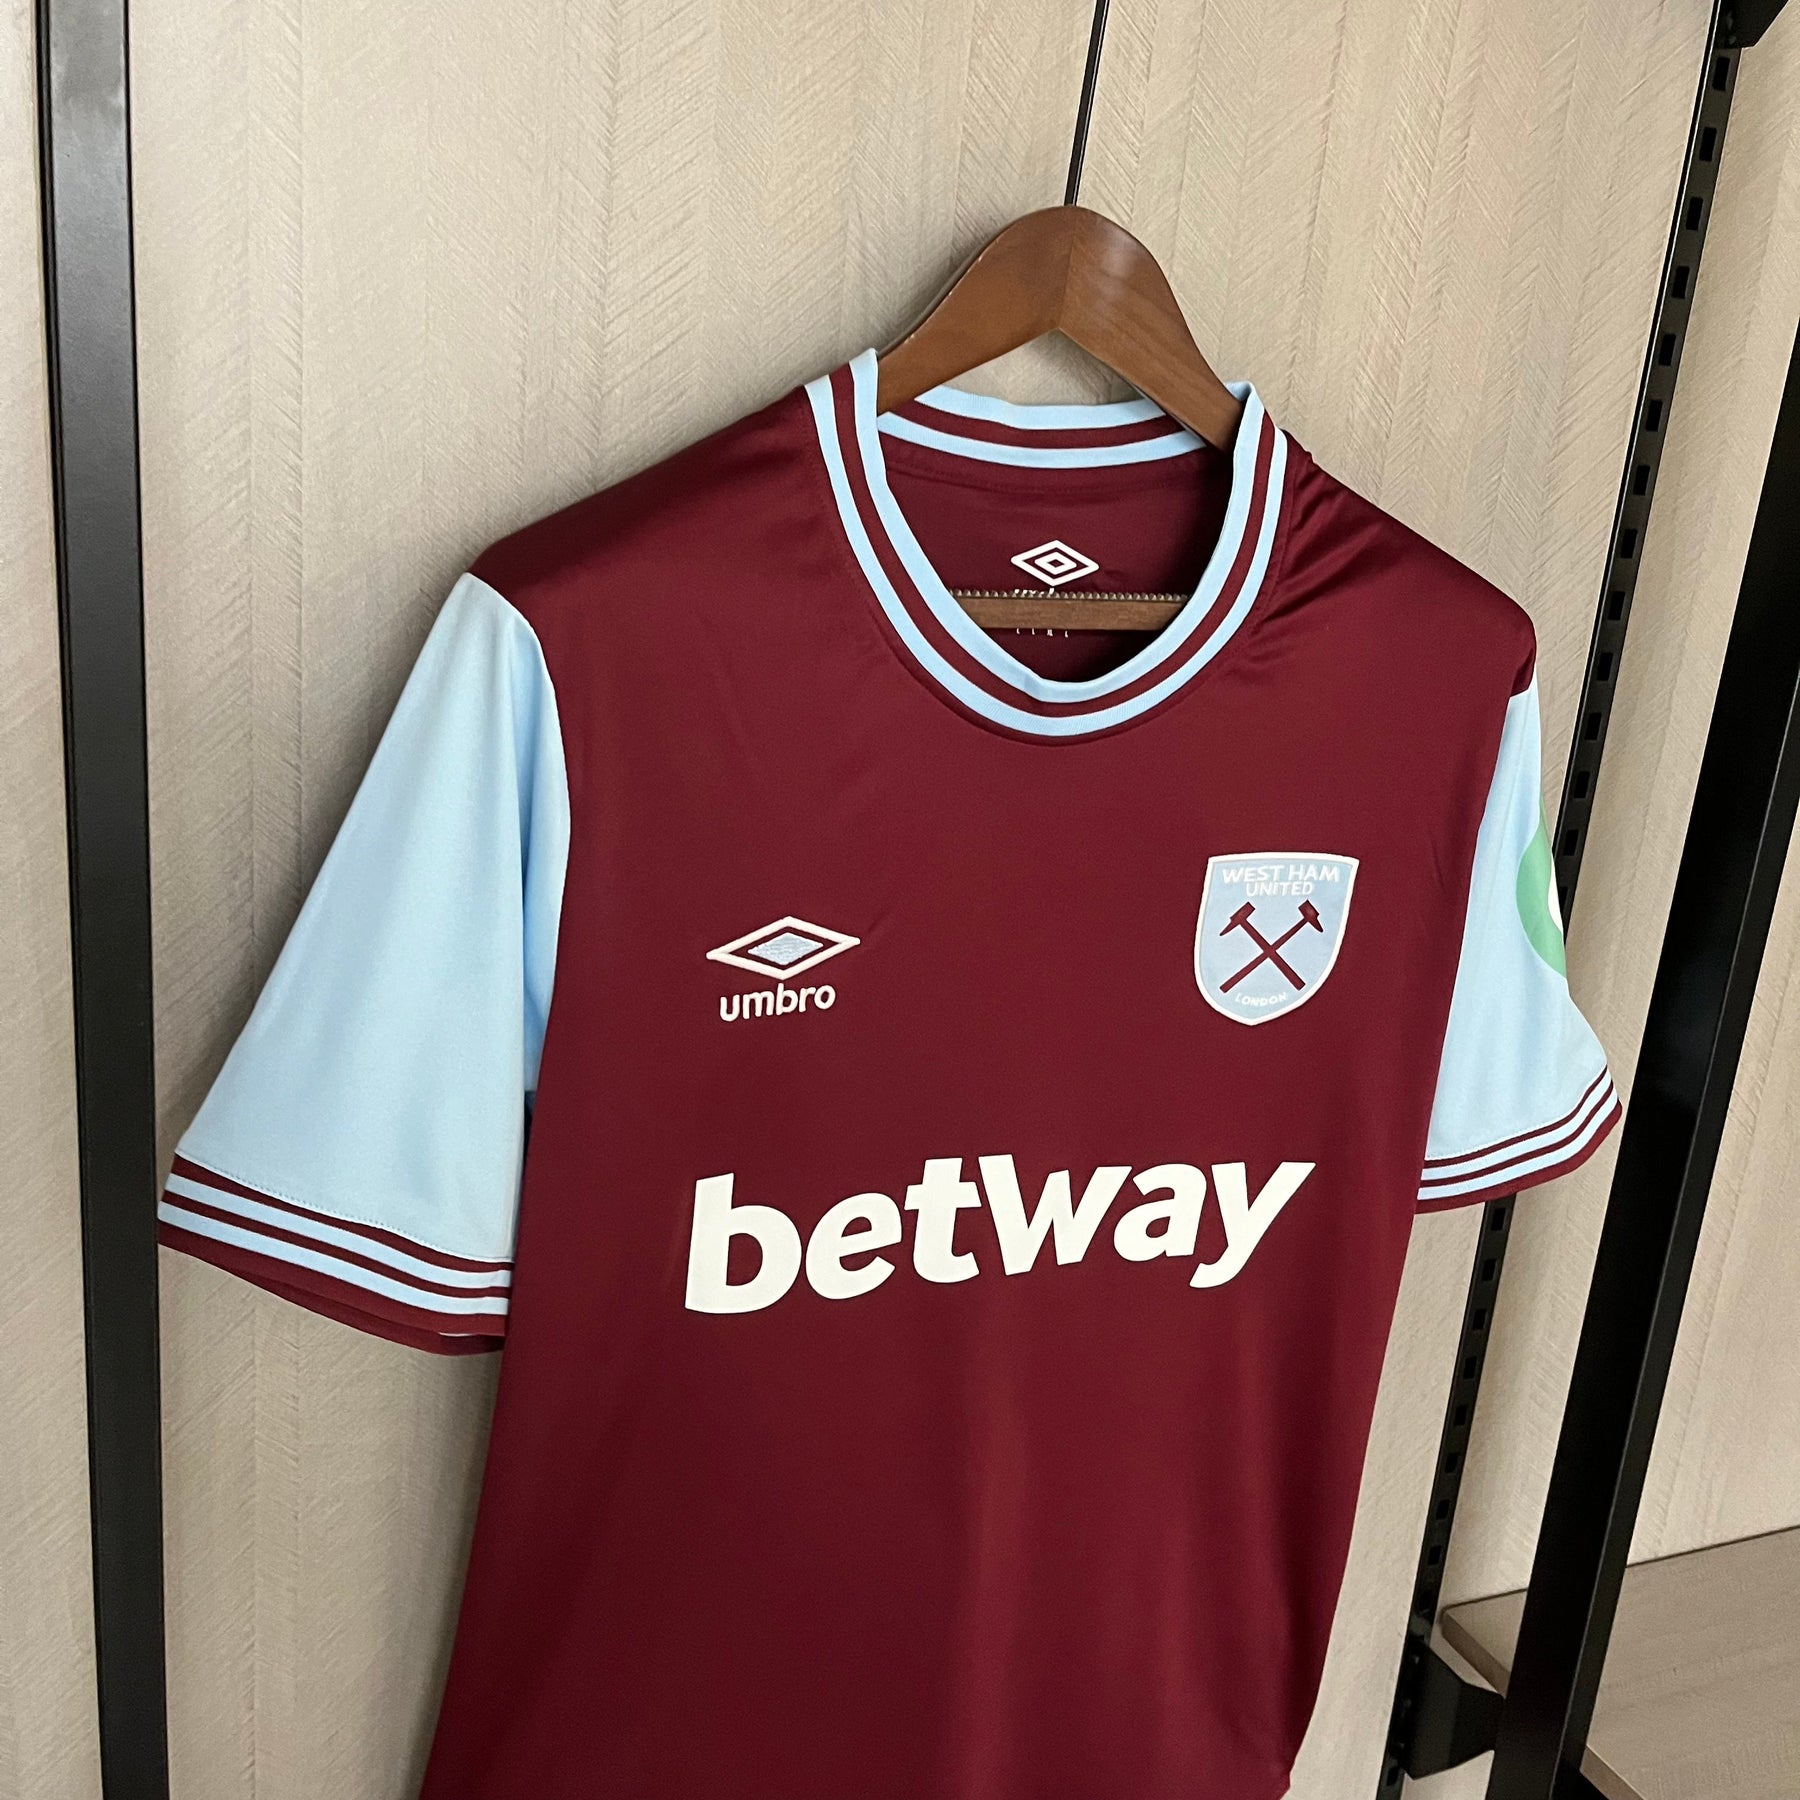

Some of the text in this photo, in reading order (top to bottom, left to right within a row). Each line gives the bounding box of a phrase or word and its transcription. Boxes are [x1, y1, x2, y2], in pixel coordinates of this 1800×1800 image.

[1222, 864, 1340, 883] WEST HAM
[1246, 881, 1315, 896] UNITED
[719, 983, 836, 1022] umbro
[1235, 992, 1288, 1006] LONDON
[685, 1154, 1316, 1314] betway
